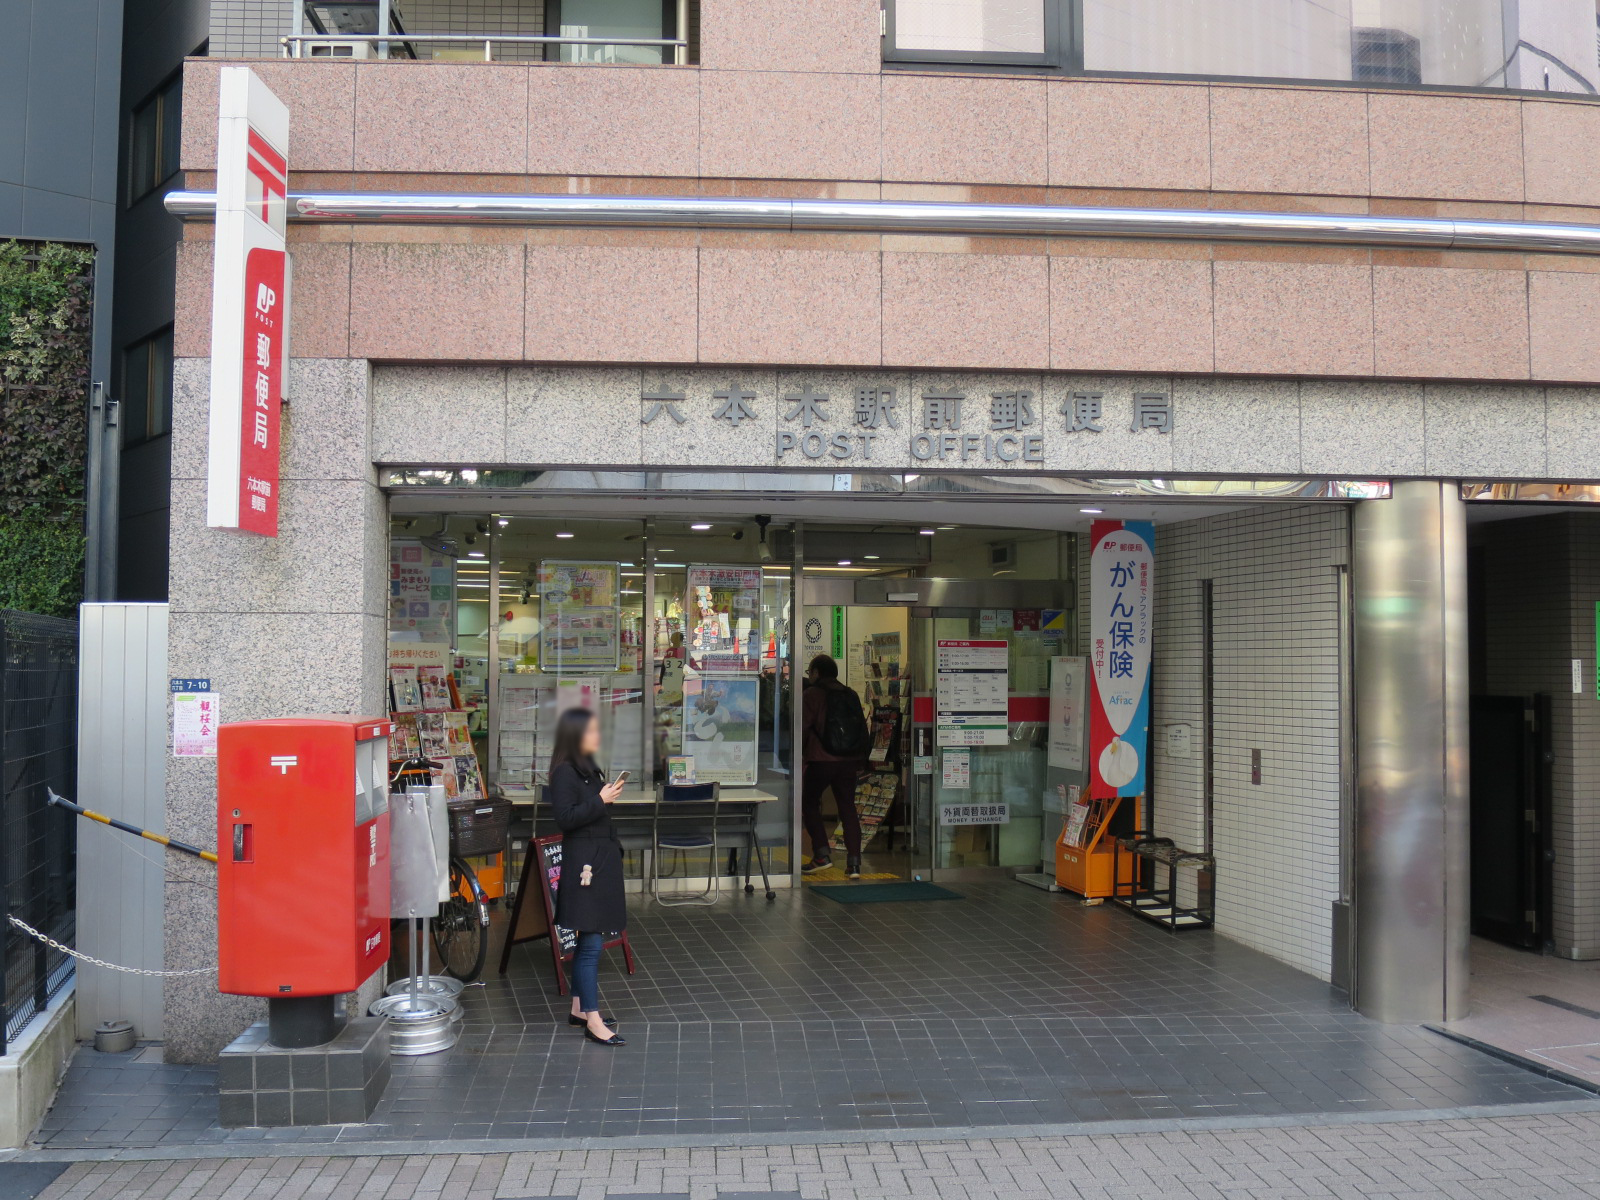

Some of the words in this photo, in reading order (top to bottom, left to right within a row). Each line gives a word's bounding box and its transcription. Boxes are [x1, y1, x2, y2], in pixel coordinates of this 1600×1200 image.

[255, 311, 274, 328] POST
[254, 332, 271, 449] 郵便局
[641, 383, 1174, 434] 六本木駅前郵便局
[777, 431, 878, 459] POST
[911, 432, 1045, 462] OFFICE
[1119, 543, 1143, 552] 郵便局
[400, 584, 430, 592] サービス
[1139, 562, 1148, 644] 郵便局でアフラックの
[1109, 561, 1135, 679] がん保険
[465, 659, 470, 667] 5
[477, 659, 484, 667] 4
[666, 660, 672, 668] 3
[677, 660, 683, 668] 2
[186, 681, 208, 690] 7-10
[1109, 694, 1133, 706] Aflac
[199, 700, 212, 736] 観桜会
[943, 805, 1006, 818] 外貨両替取扱局
